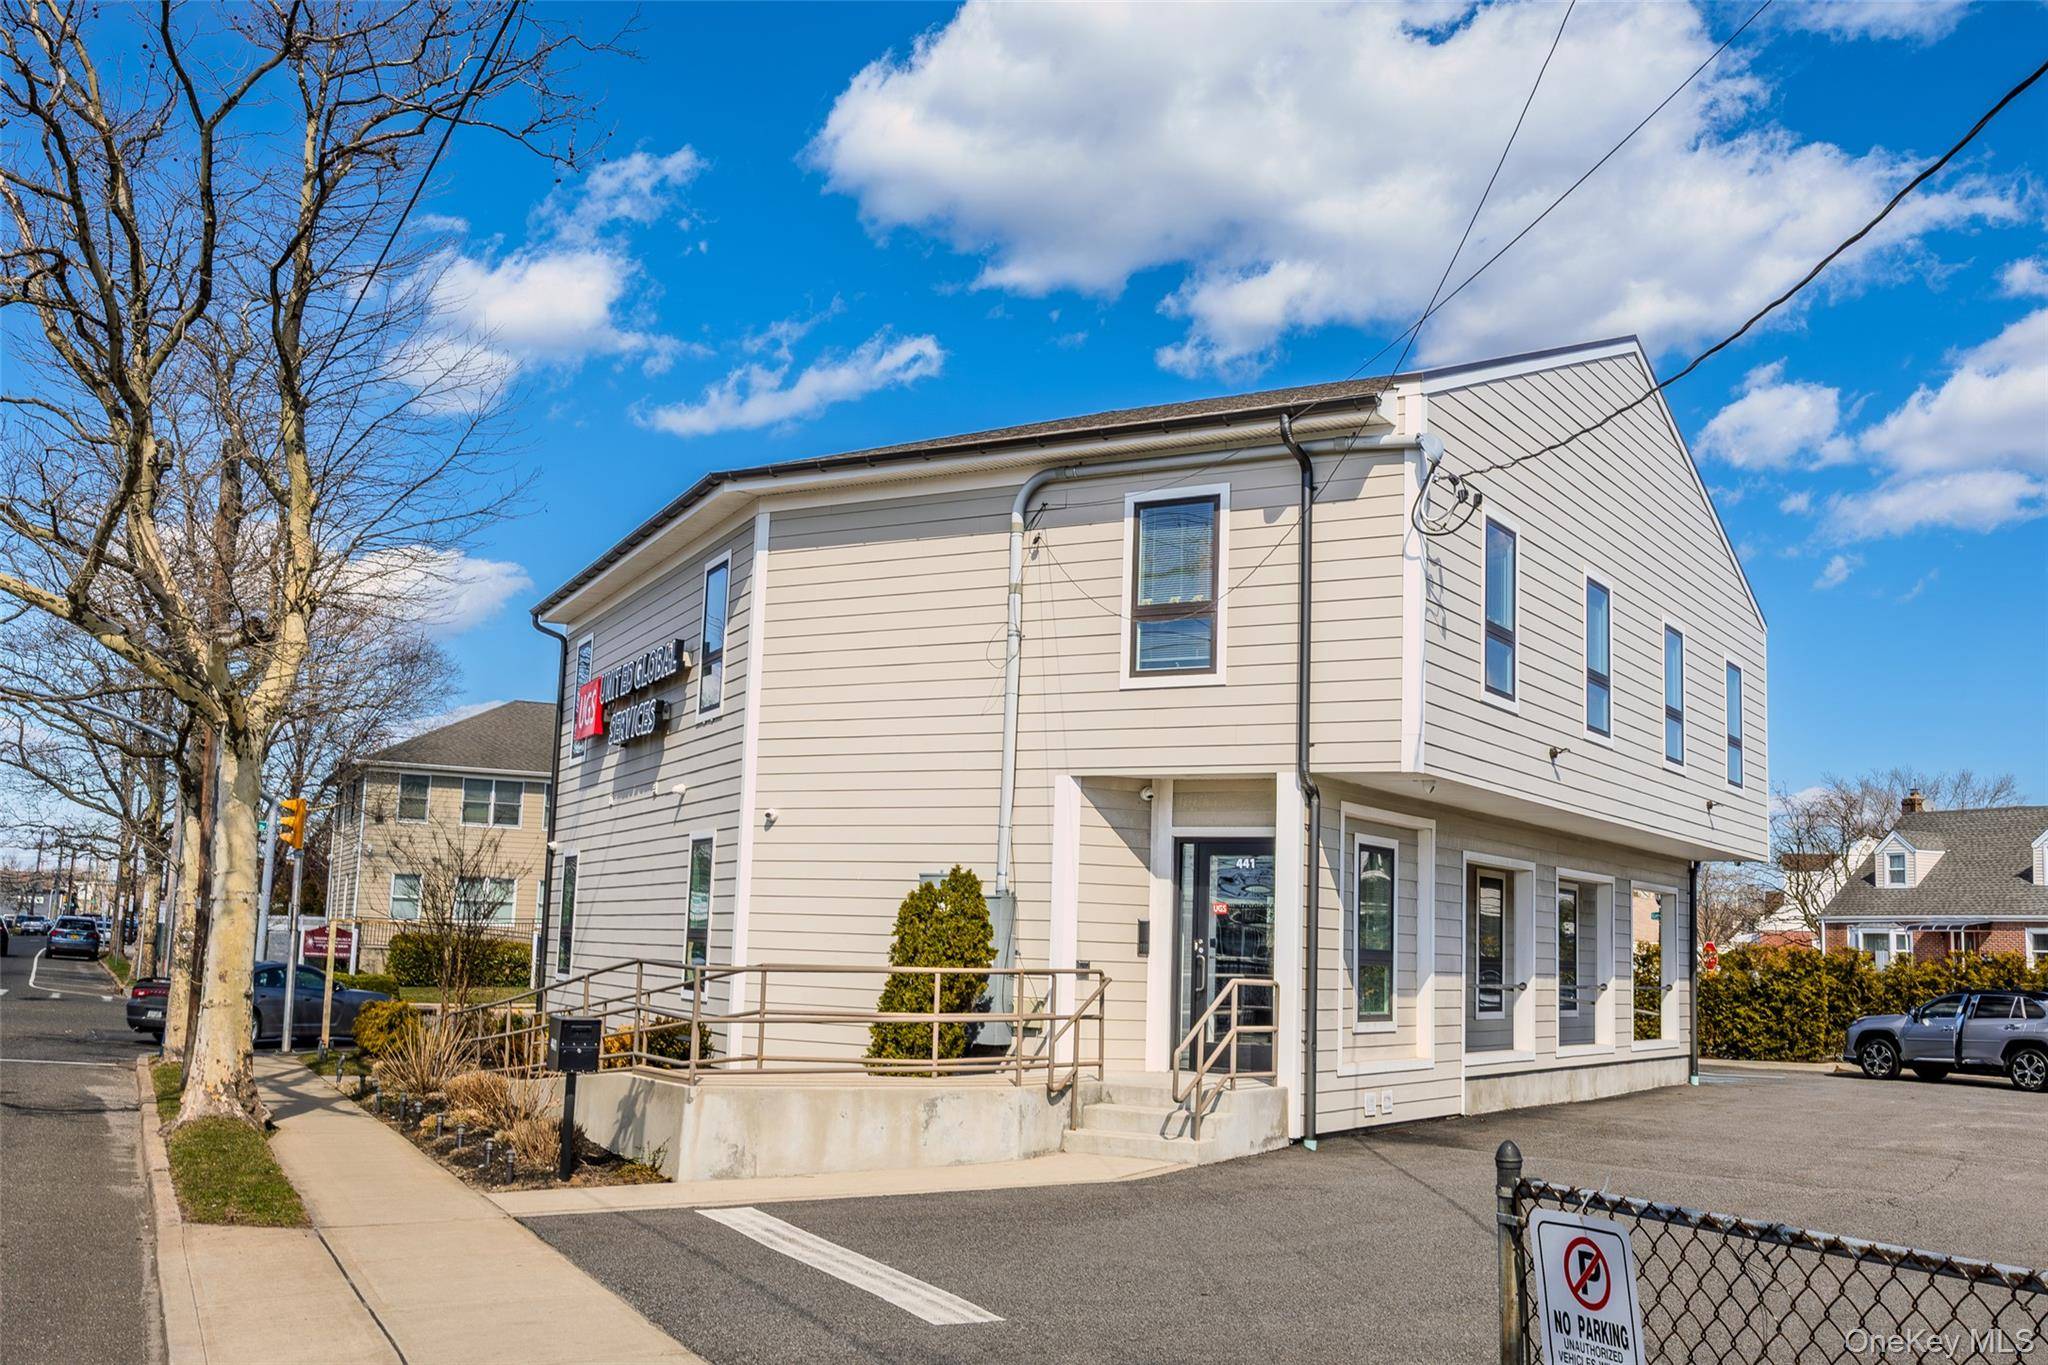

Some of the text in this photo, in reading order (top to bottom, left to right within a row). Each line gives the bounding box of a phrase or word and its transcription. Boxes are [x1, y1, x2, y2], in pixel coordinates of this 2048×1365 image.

[599, 639, 678, 704] UNITED GLOBAL
[578, 689, 597, 729] UGS
[608, 698, 657, 745] SERVICES
[1236, 858, 1255, 869] 441
[1553, 1309, 1630, 1350] NO PARKING
[1563, 1337, 1624, 1364] UNAUTHORIZED
